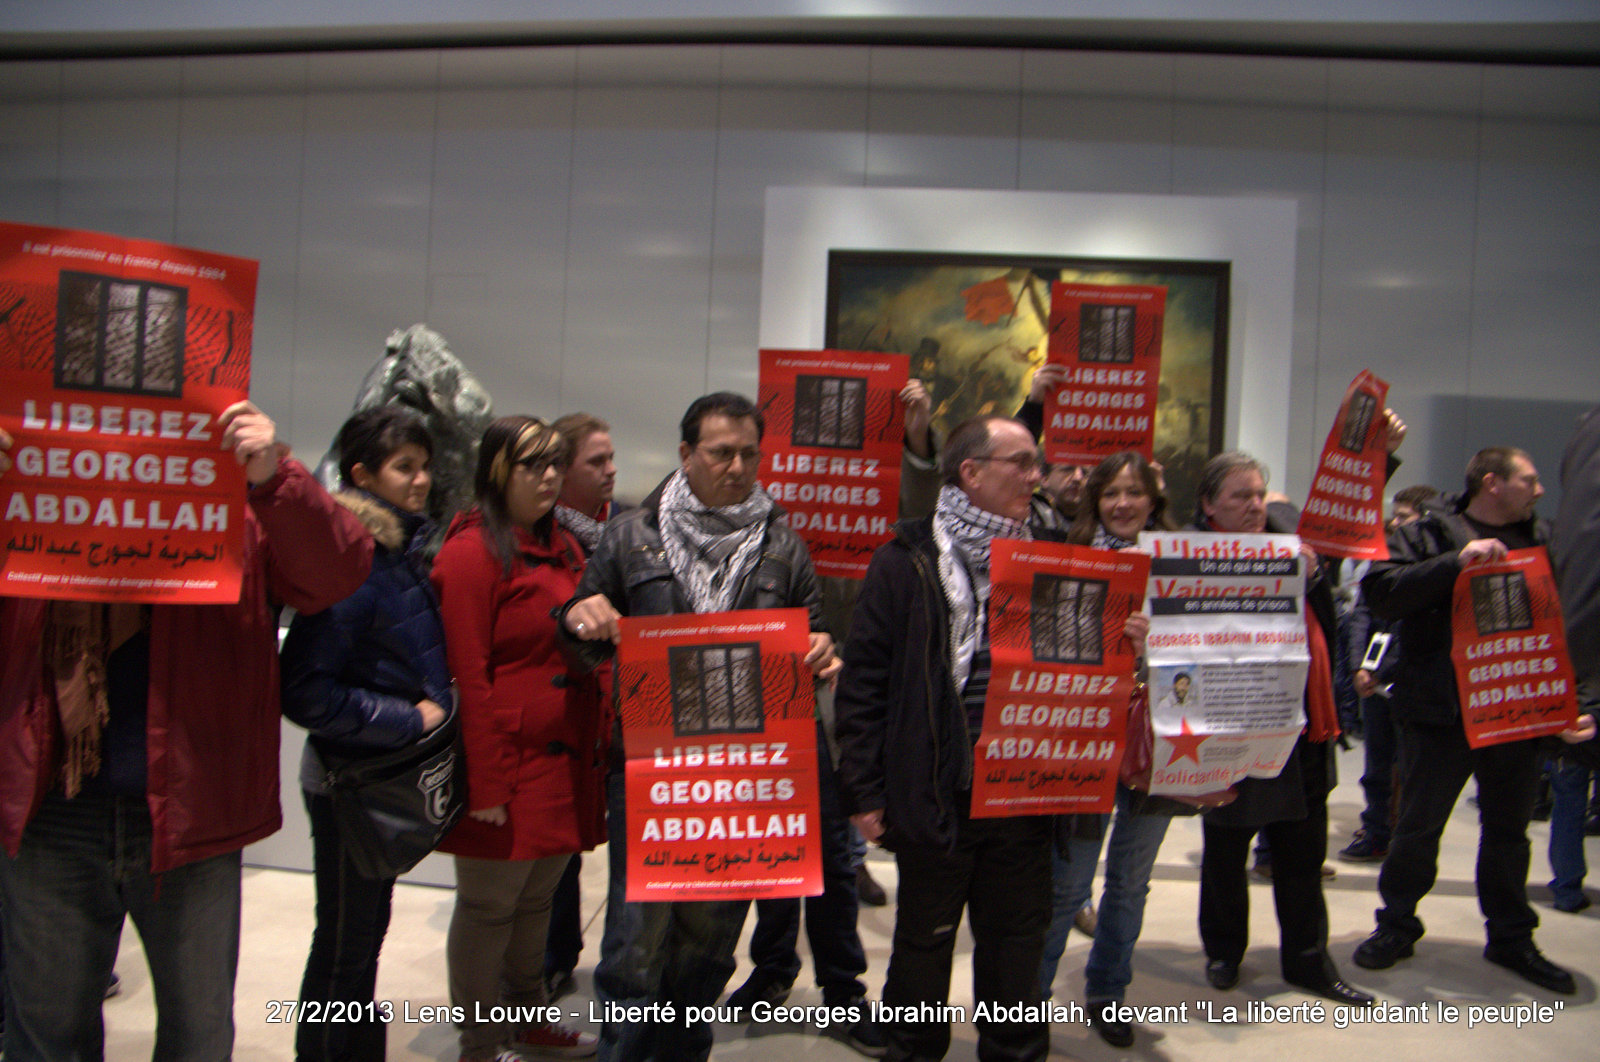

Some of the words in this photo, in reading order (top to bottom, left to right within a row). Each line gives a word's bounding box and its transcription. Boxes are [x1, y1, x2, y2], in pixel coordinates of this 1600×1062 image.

[107, 252, 124, 265] en
[123, 253, 159, 270] France
[160, 259, 197, 277] depuis
[197, 265, 227, 280] 1984
[1063, 367, 1147, 386] LIBEREZ
[1057, 389, 1147, 409] GEORGES
[22, 400, 212, 441] LIBEREZ
[1050, 412, 1150, 432] ABDALLAH
[16, 445, 217, 486] GEORGES
[771, 452, 881, 479] LIBEREZ
[766, 481, 882, 507] GEORGES
[4, 491, 229, 532] ABDALLAH
[1304, 496, 1379, 527] ABDALLAH
[1155, 578, 1266, 599] Vaincra
[1274, 577, 1283, 595] !
[710, 624, 737, 634] France
[737, 622, 763, 634] depuis
[1148, 632, 1202, 649] GEORGES
[1202, 631, 1253, 647] IBRAHIM
[1465, 633, 1553, 661] LIBEREZ
[1008, 670, 1120, 696] LIBEREZ
[1468, 655, 1559, 684] GEORGES
[1467, 678, 1569, 710] ABDALLAH
[1000, 703, 1112, 730] GEORGES
[653, 742, 788, 768] LIBEREZ
[984, 737, 1117, 761] ABDALLAH
[1153, 763, 1230, 786] Solidarité
[649, 778, 795, 805] GEORGES
[641, 812, 807, 842] ABDALLAH
